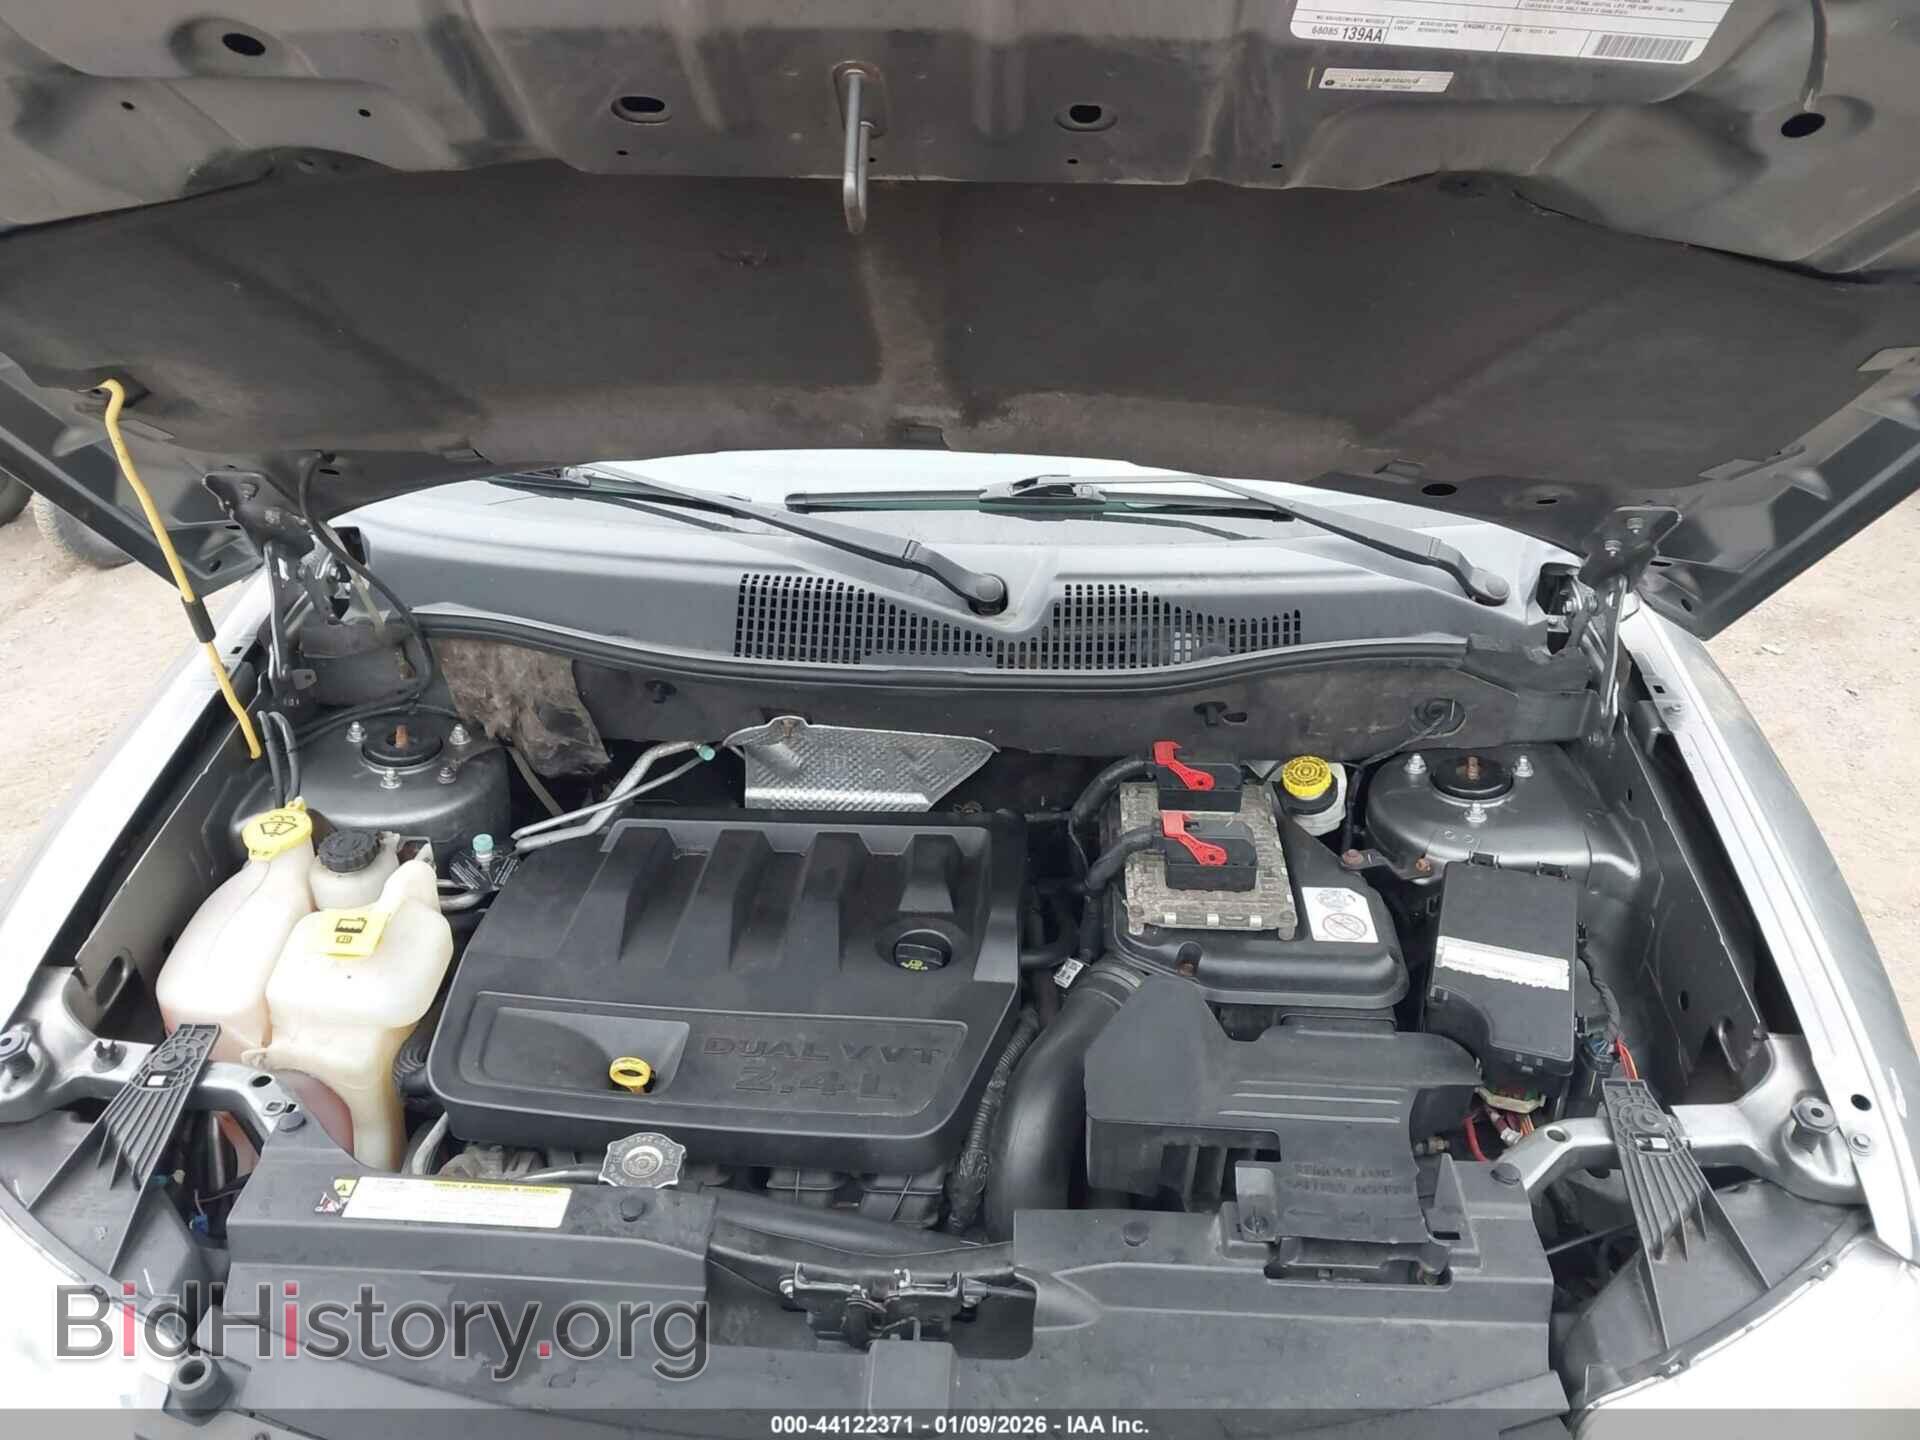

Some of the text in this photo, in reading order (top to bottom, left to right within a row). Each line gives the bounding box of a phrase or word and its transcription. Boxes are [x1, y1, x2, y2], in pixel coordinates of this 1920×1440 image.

[1342, 26, 1383, 43] 139AA
[704, 1037, 942, 1064] DUAL VVT
[735, 1063, 898, 1101] 2.4L
